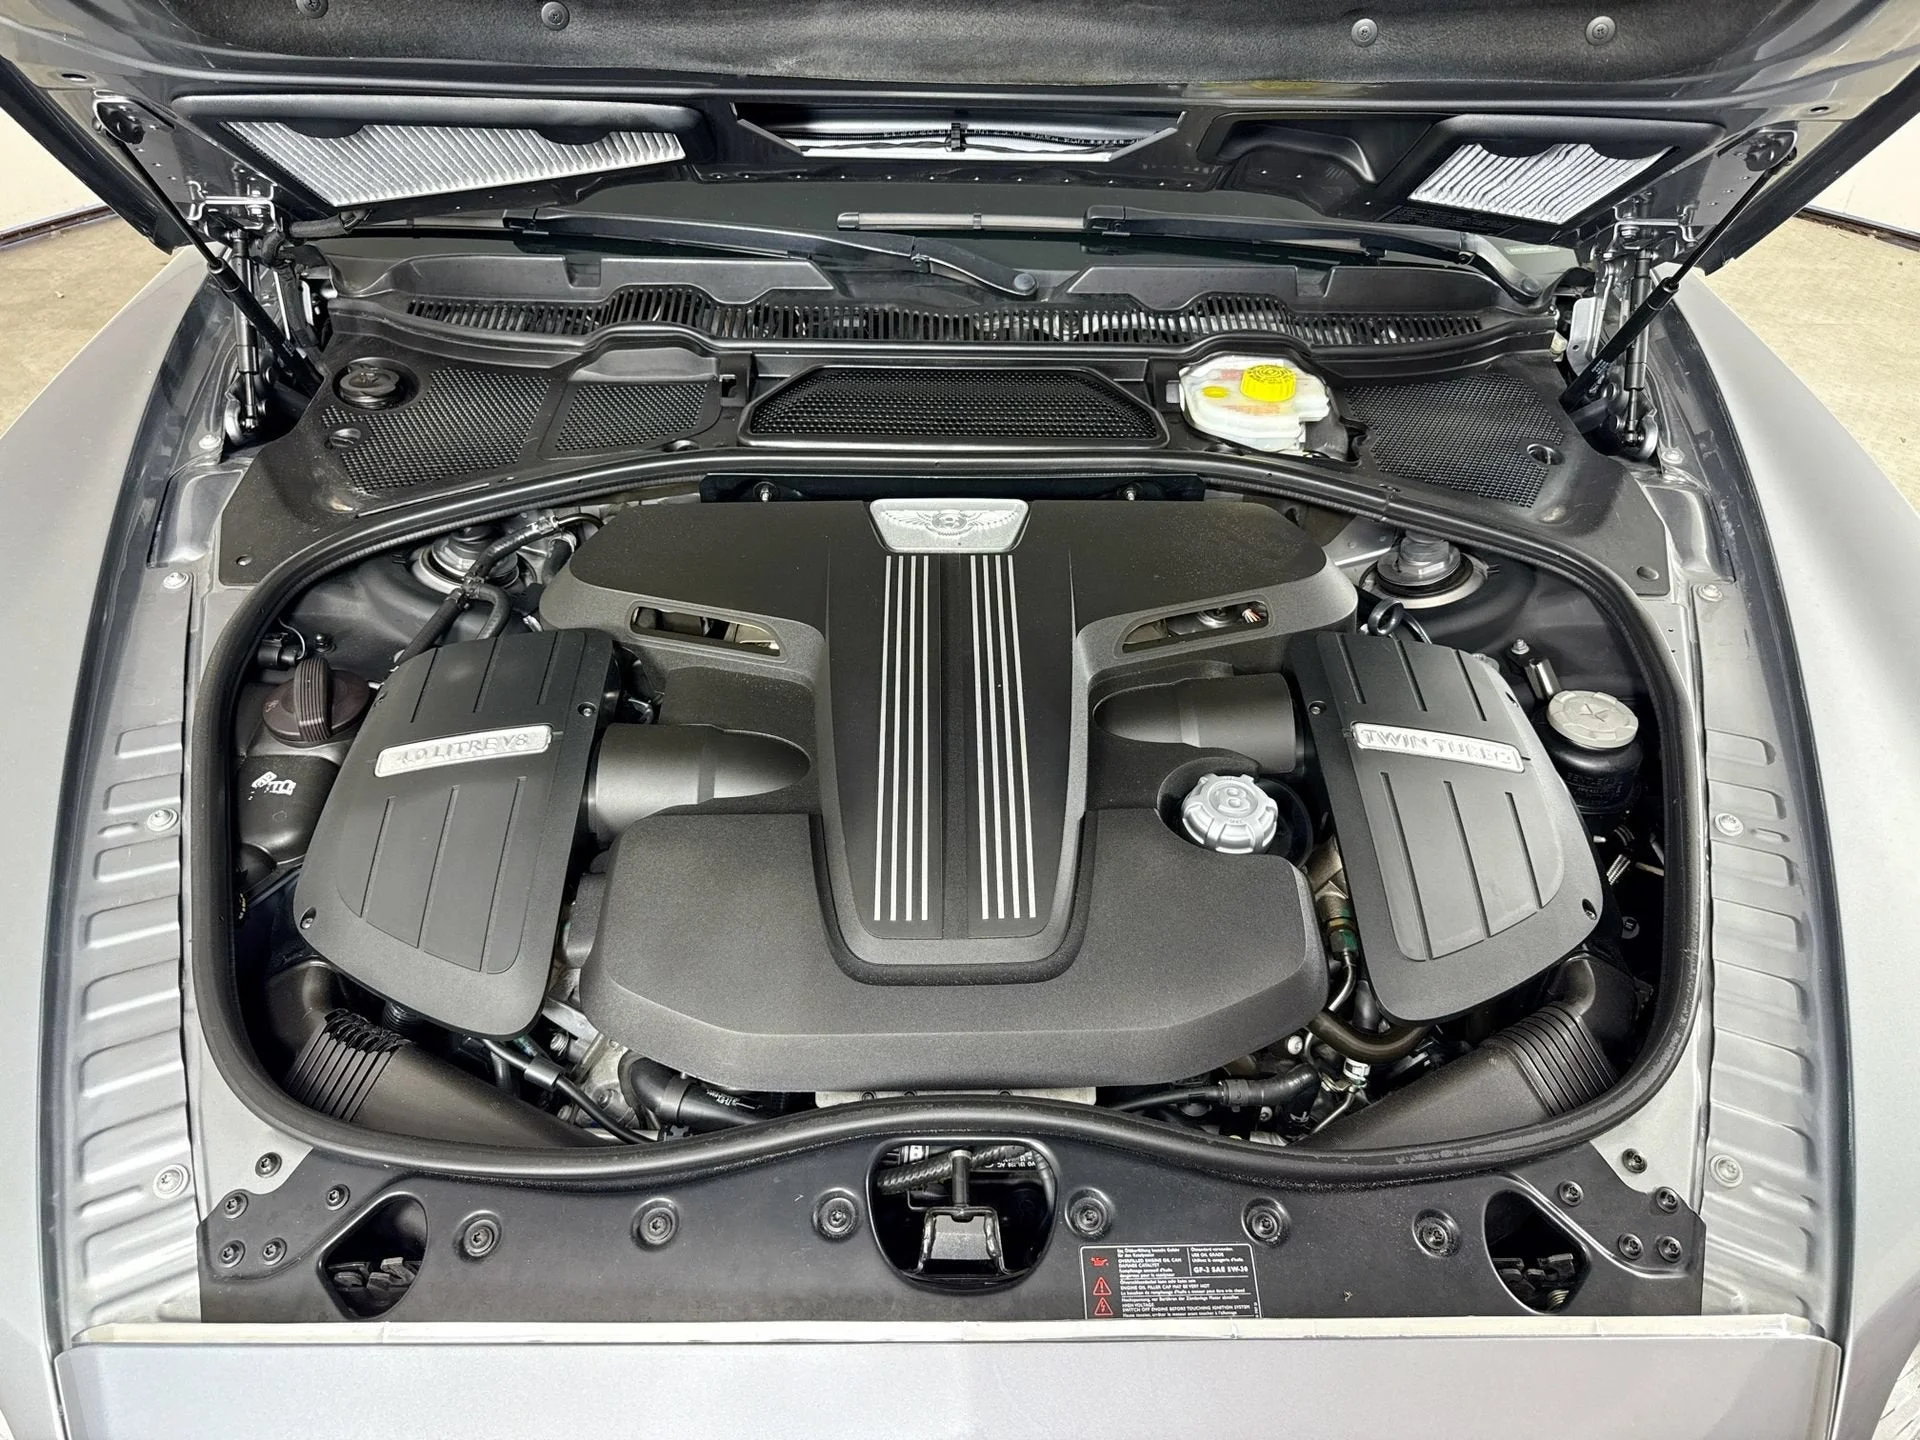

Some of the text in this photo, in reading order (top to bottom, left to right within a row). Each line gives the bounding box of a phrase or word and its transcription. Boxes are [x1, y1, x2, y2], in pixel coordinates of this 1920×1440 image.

[433, 737, 498, 757] LITRE
[502, 733, 529, 748] V8
[1361, 729, 1512, 765] TWIN TURBO
